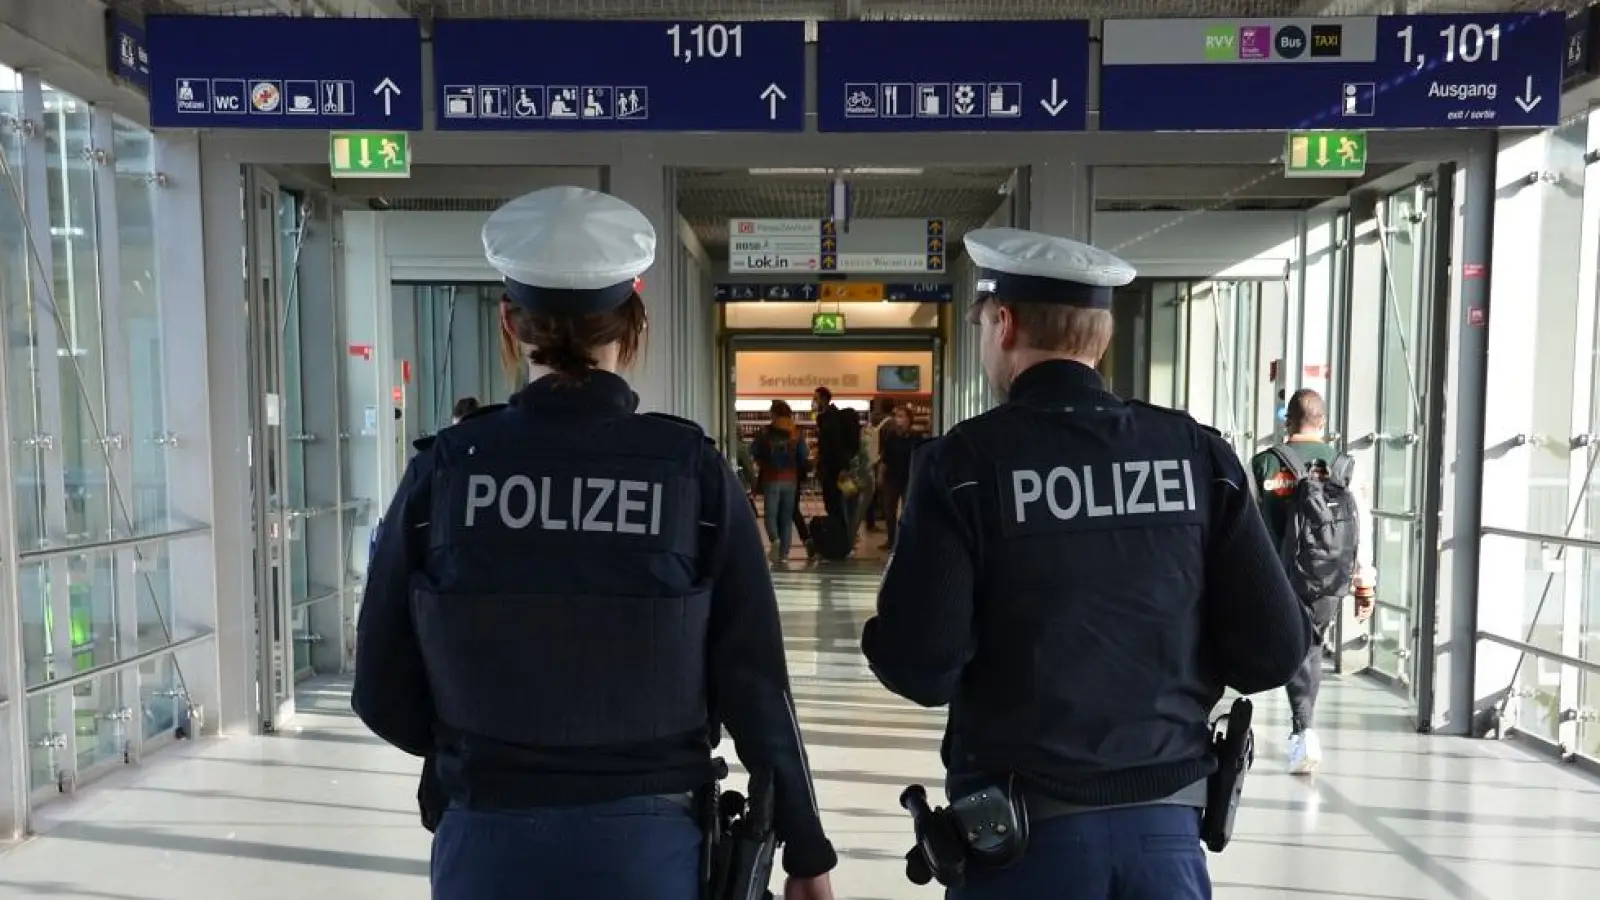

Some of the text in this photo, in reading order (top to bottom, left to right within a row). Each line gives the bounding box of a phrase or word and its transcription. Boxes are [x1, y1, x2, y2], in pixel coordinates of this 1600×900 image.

[667, 24, 742, 63] 1,101
[1205, 35, 1234, 48] RVV
[1281, 36, 1302, 48] Bus
[1314, 35, 1338, 47] TAXI
[1397, 23, 1500, 70] 1, 101
[1428, 81, 1497, 100] Ausgang
[216, 95, 239, 109] WC
[1447, 110, 1463, 120] exit
[1470, 110, 1496, 120] sortie
[747, 254, 788, 269] Lok.in
[759, 373, 840, 387] ServiceStore
[1012, 459, 1196, 523] POLIZEI
[465, 474, 663, 535] POLIZEI
